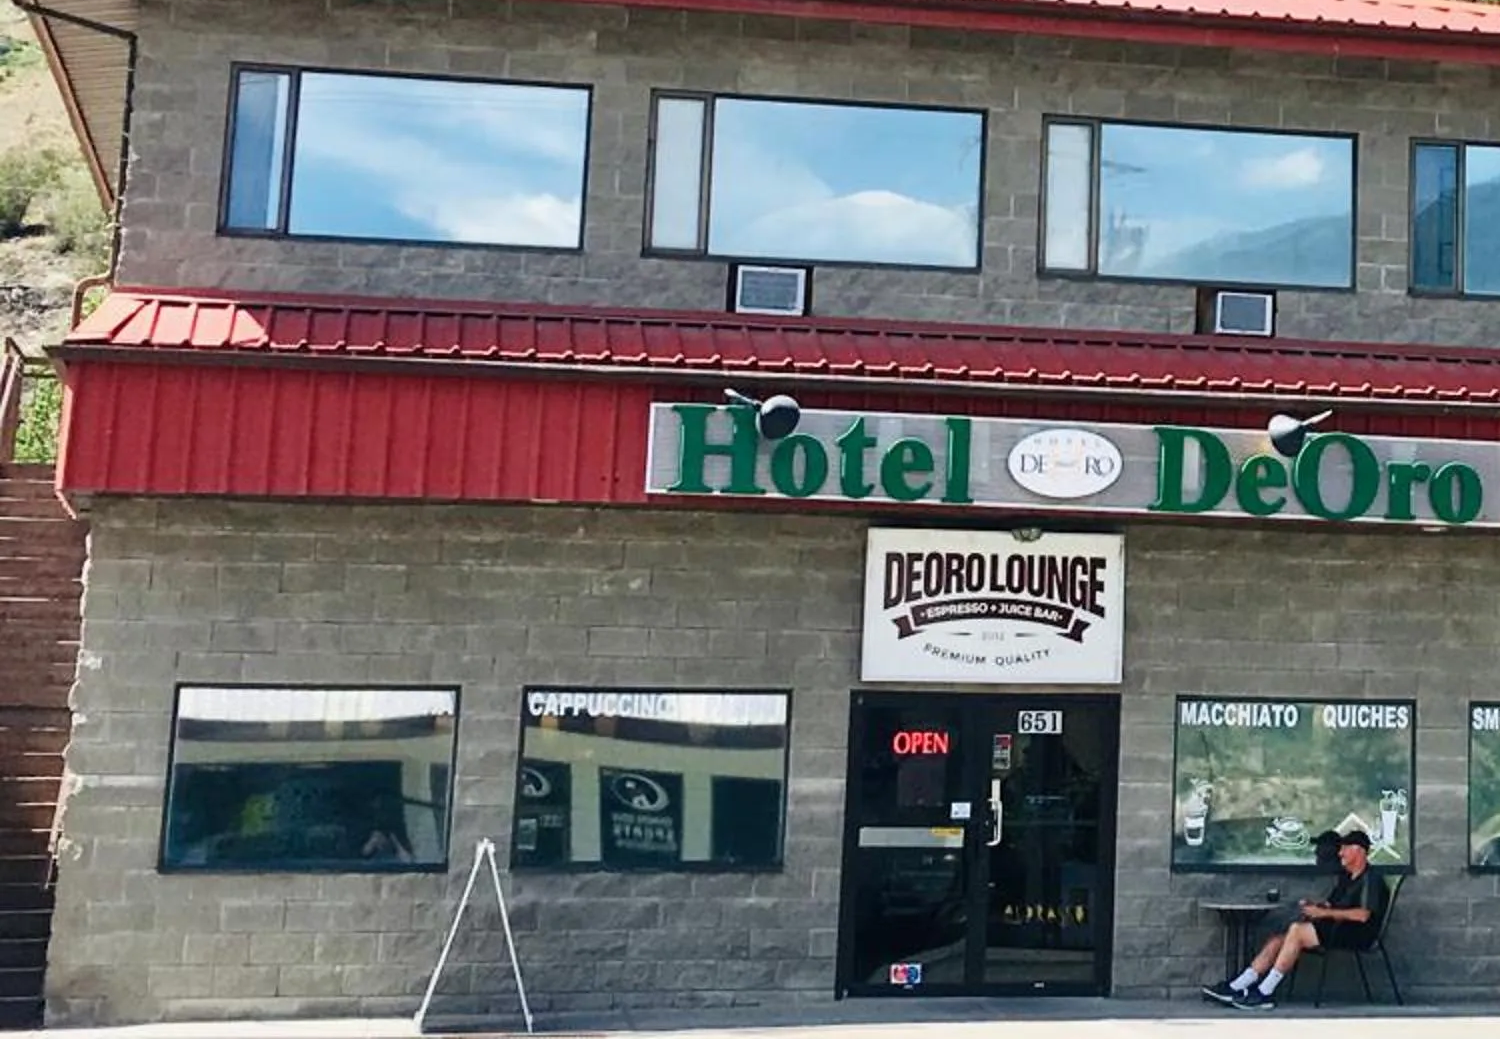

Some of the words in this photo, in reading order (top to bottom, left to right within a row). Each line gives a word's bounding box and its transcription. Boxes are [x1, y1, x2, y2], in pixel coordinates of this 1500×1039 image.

[667, 404, 974, 504] Hotel
[1147, 425, 1483, 524] DeOro
[884, 551, 987, 610] DEORO
[989, 552, 1107, 619] LOUNGE
[926, 602, 988, 619] ESPRESSO
[998, 604, 1033, 616] JUICE
[1033, 609, 1059, 622] BAR
[923, 642, 987, 665] PREMIUM
[995, 649, 1050, 666] QUALITY
[527, 691, 675, 719] CAPPUCCINO
[1180, 702, 1299, 728] MACCHIATO
[1322, 704, 1409, 729] QUICHES
[1020, 712, 1061, 732] 651
[893, 731, 949, 754] OPEN
